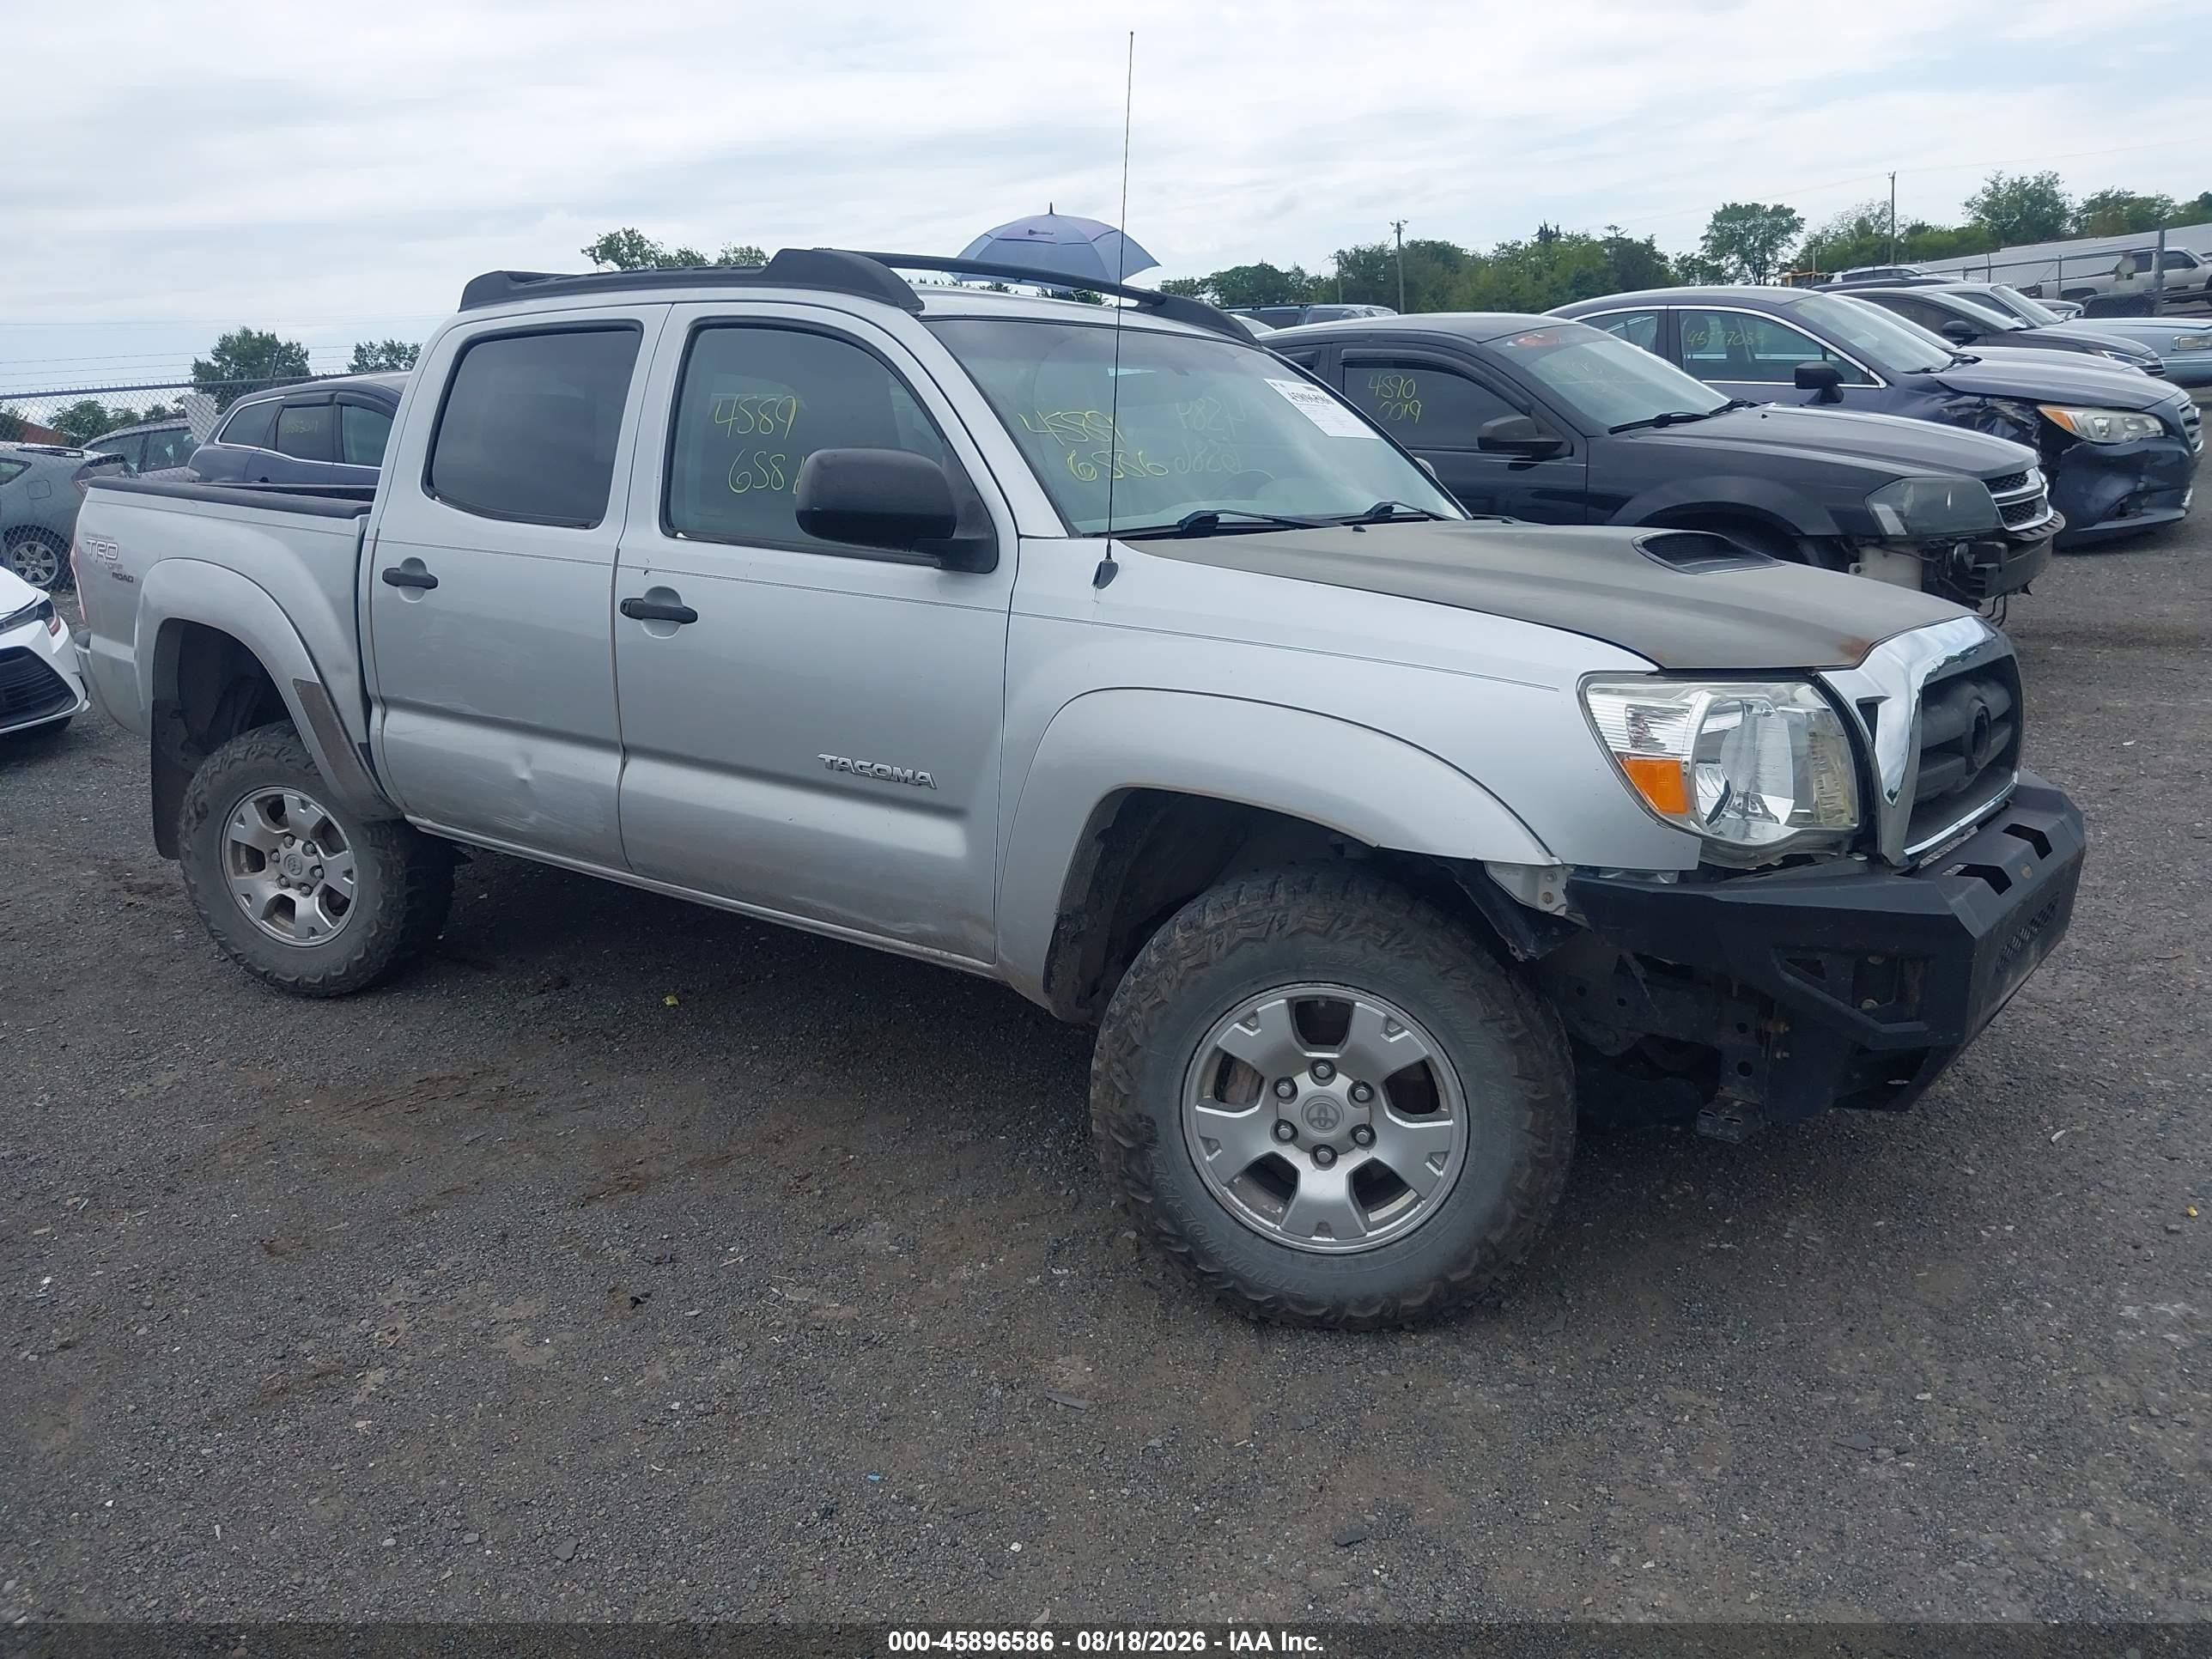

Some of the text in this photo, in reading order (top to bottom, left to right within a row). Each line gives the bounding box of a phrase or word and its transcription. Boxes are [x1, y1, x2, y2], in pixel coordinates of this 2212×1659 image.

[1367, 374, 1416, 399] 4590
[714, 395, 798, 440] 4589
[1377, 399, 1423, 424] 0019
[86, 538, 118, 563] TRD
[112, 571, 134, 582] ROAD
[817, 752, 939, 790] TACOMA
